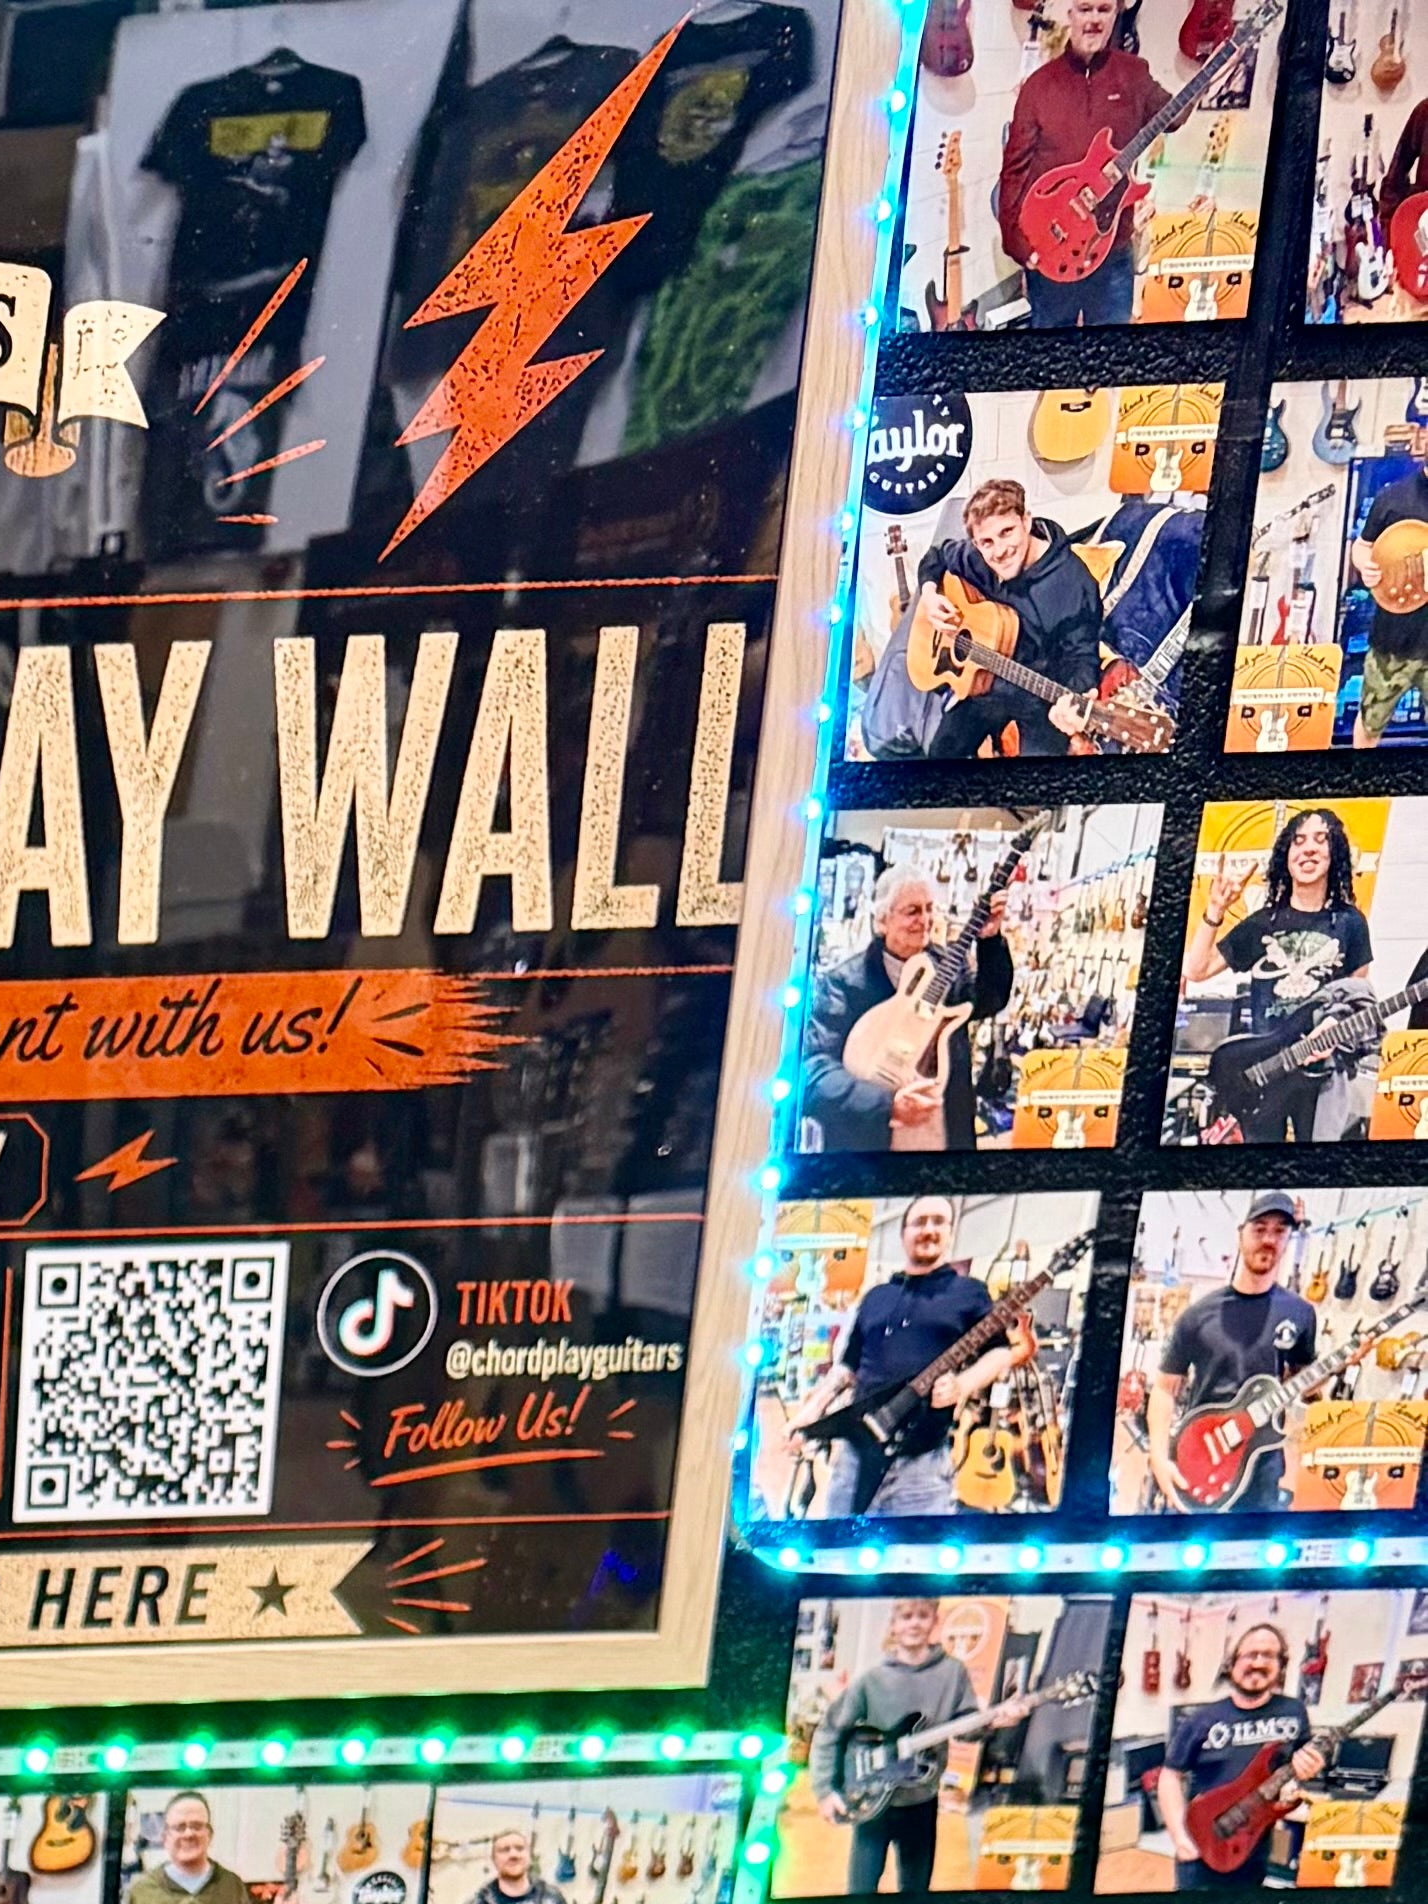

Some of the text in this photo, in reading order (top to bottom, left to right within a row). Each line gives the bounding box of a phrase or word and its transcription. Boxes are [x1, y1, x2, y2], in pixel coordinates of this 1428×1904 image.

[867, 409, 965, 473] aylor
[274, 622, 747, 938] WALL
[82, 993, 224, 1060] with
[238, 975, 361, 1058] us!
[456, 1278, 575, 1327] TIKTOK
[445, 1334, 684, 1383] @chordplayguitars
[383, 1382, 594, 1461] Follow Us!
[26, 1561, 218, 1632] HERE
